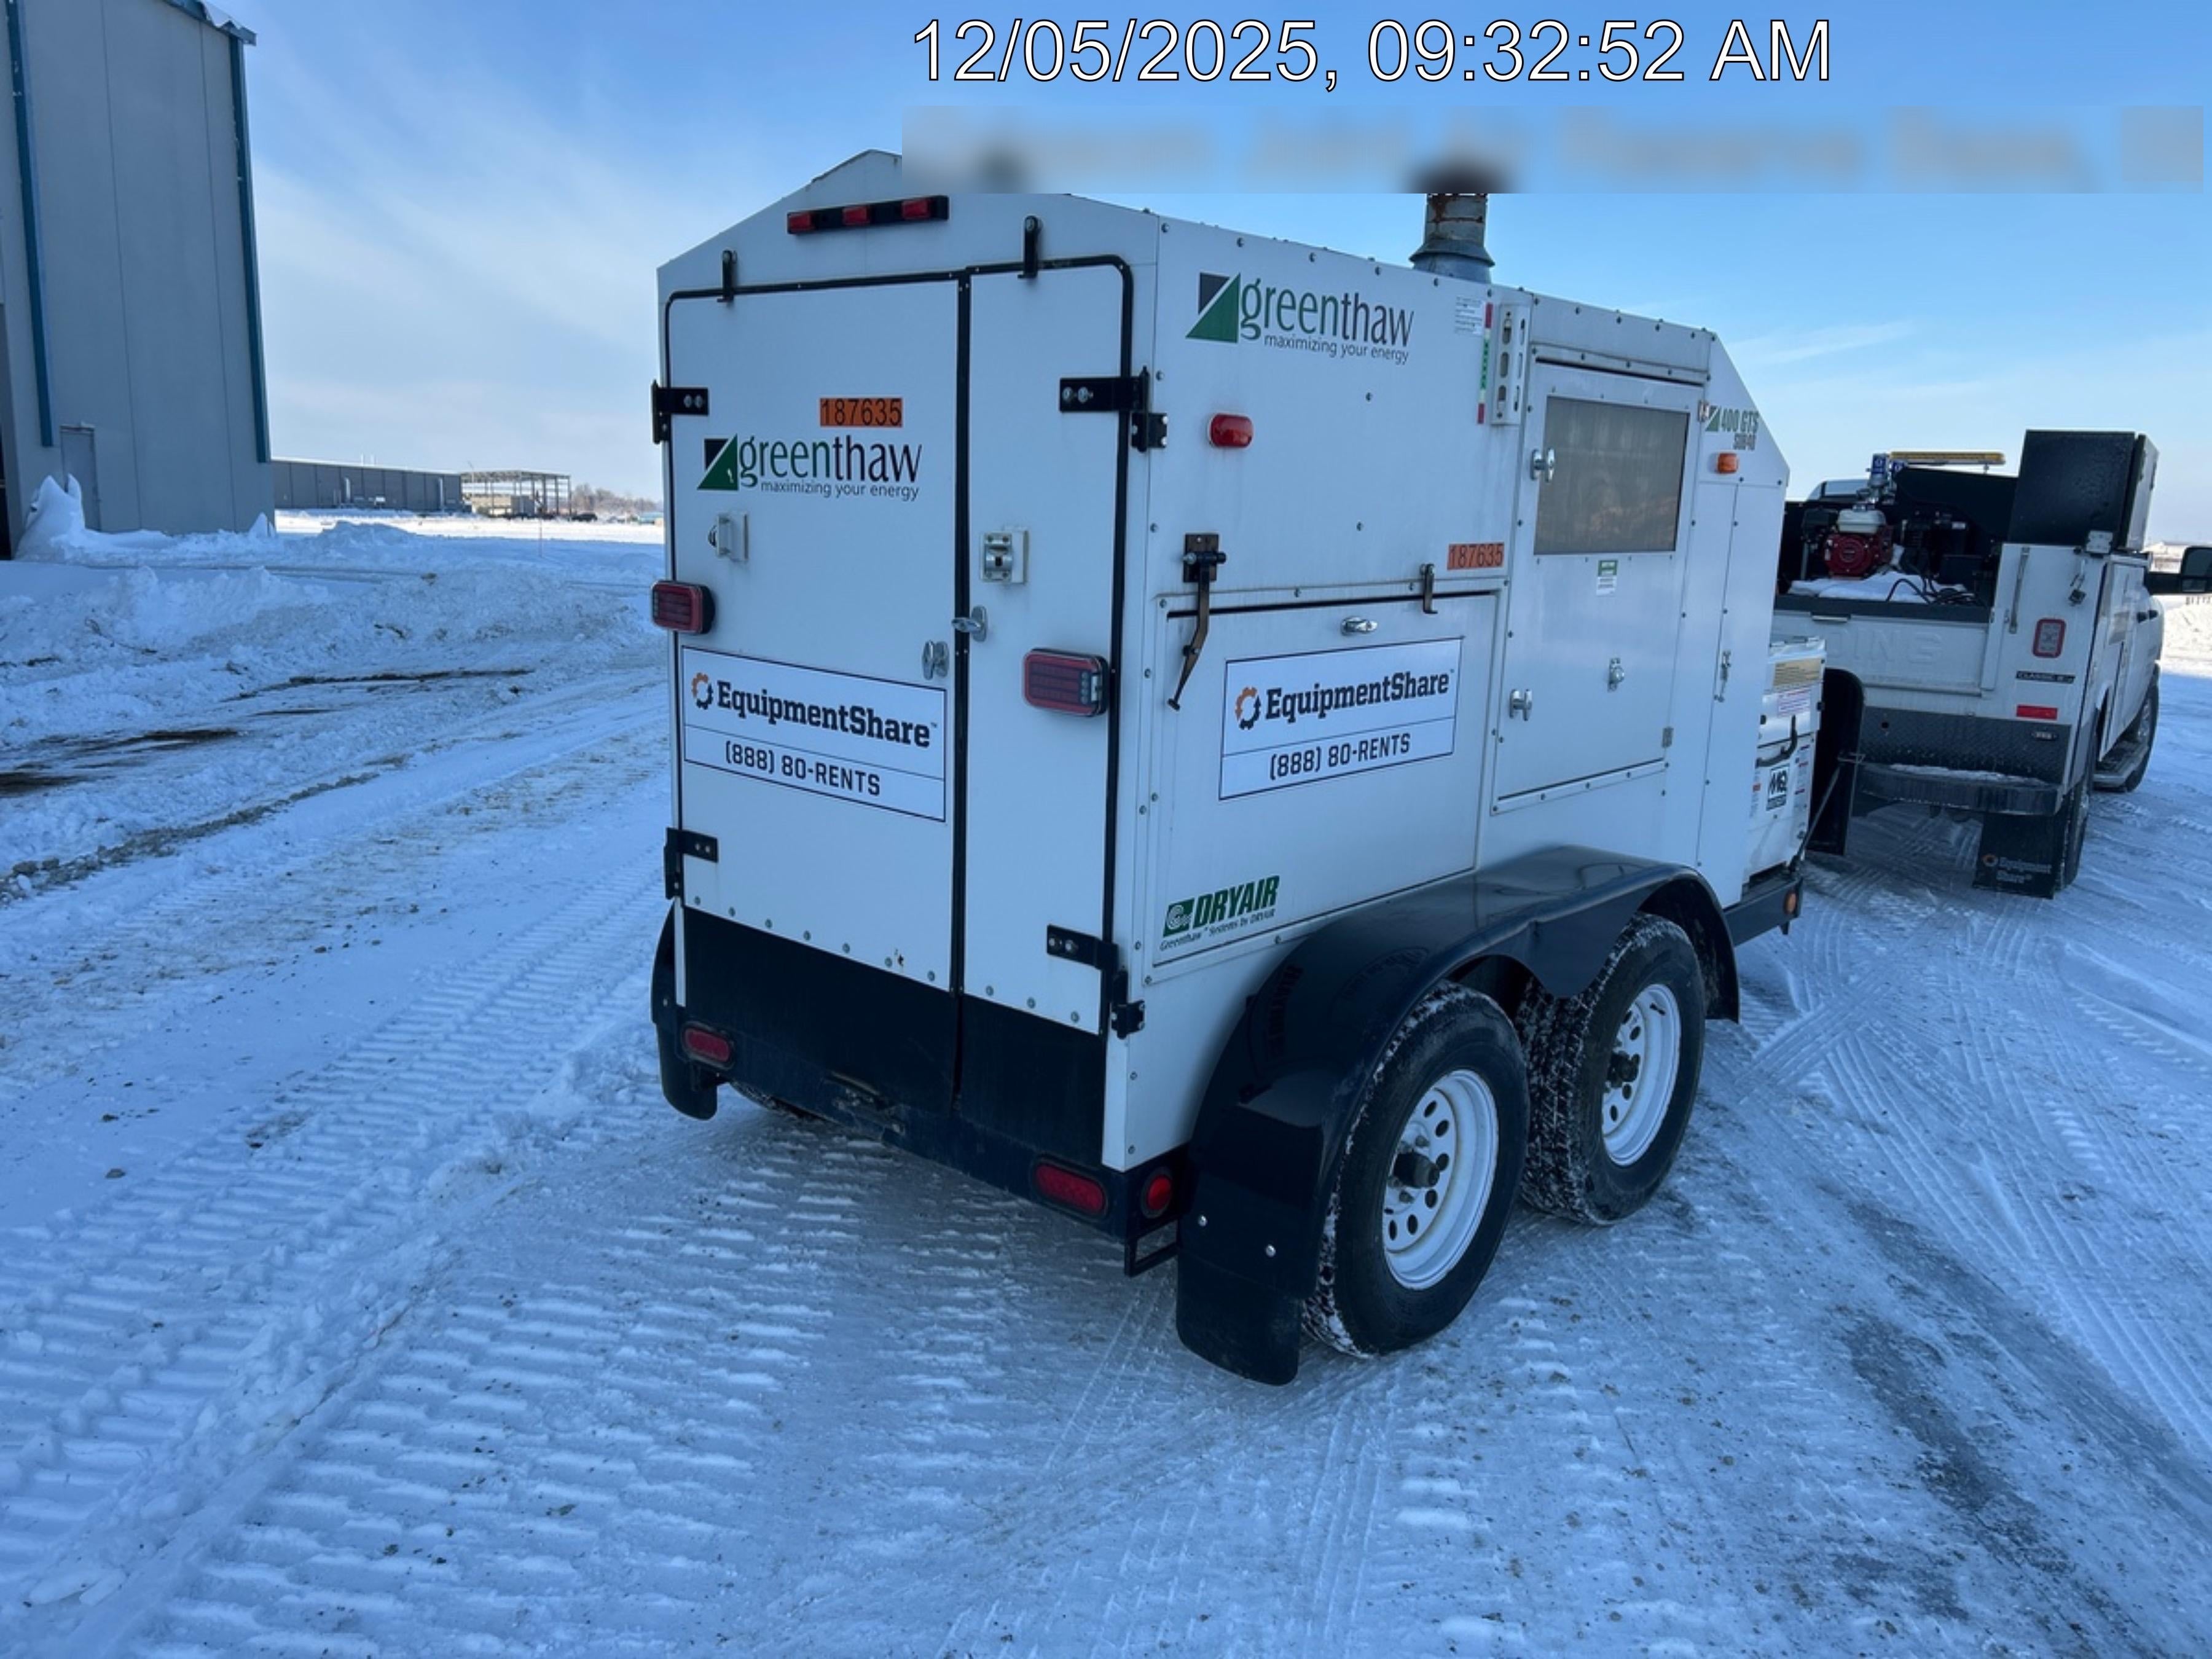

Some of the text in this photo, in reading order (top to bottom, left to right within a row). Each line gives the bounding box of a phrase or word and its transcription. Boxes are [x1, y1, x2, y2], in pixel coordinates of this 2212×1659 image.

[1239, 278, 1414, 347] greenthaw
[1264, 332, 1410, 365] maximizing your energy
[821, 398, 902, 426] 187635
[1721, 408, 1740, 433] 400
[739, 434, 922, 488] greenthaw
[761, 479, 919, 502] maximizing your energy
[1448, 543, 1504, 568] 187635
[716, 680, 930, 748] EquipmentShare
[1265, 671, 1449, 724] EquipmentShare
[725, 740, 880, 796] (888) 80-RENTS
[1269, 733, 1411, 780] (888) 80-RENTS
[1192, 875, 1280, 929] DRYAIR
